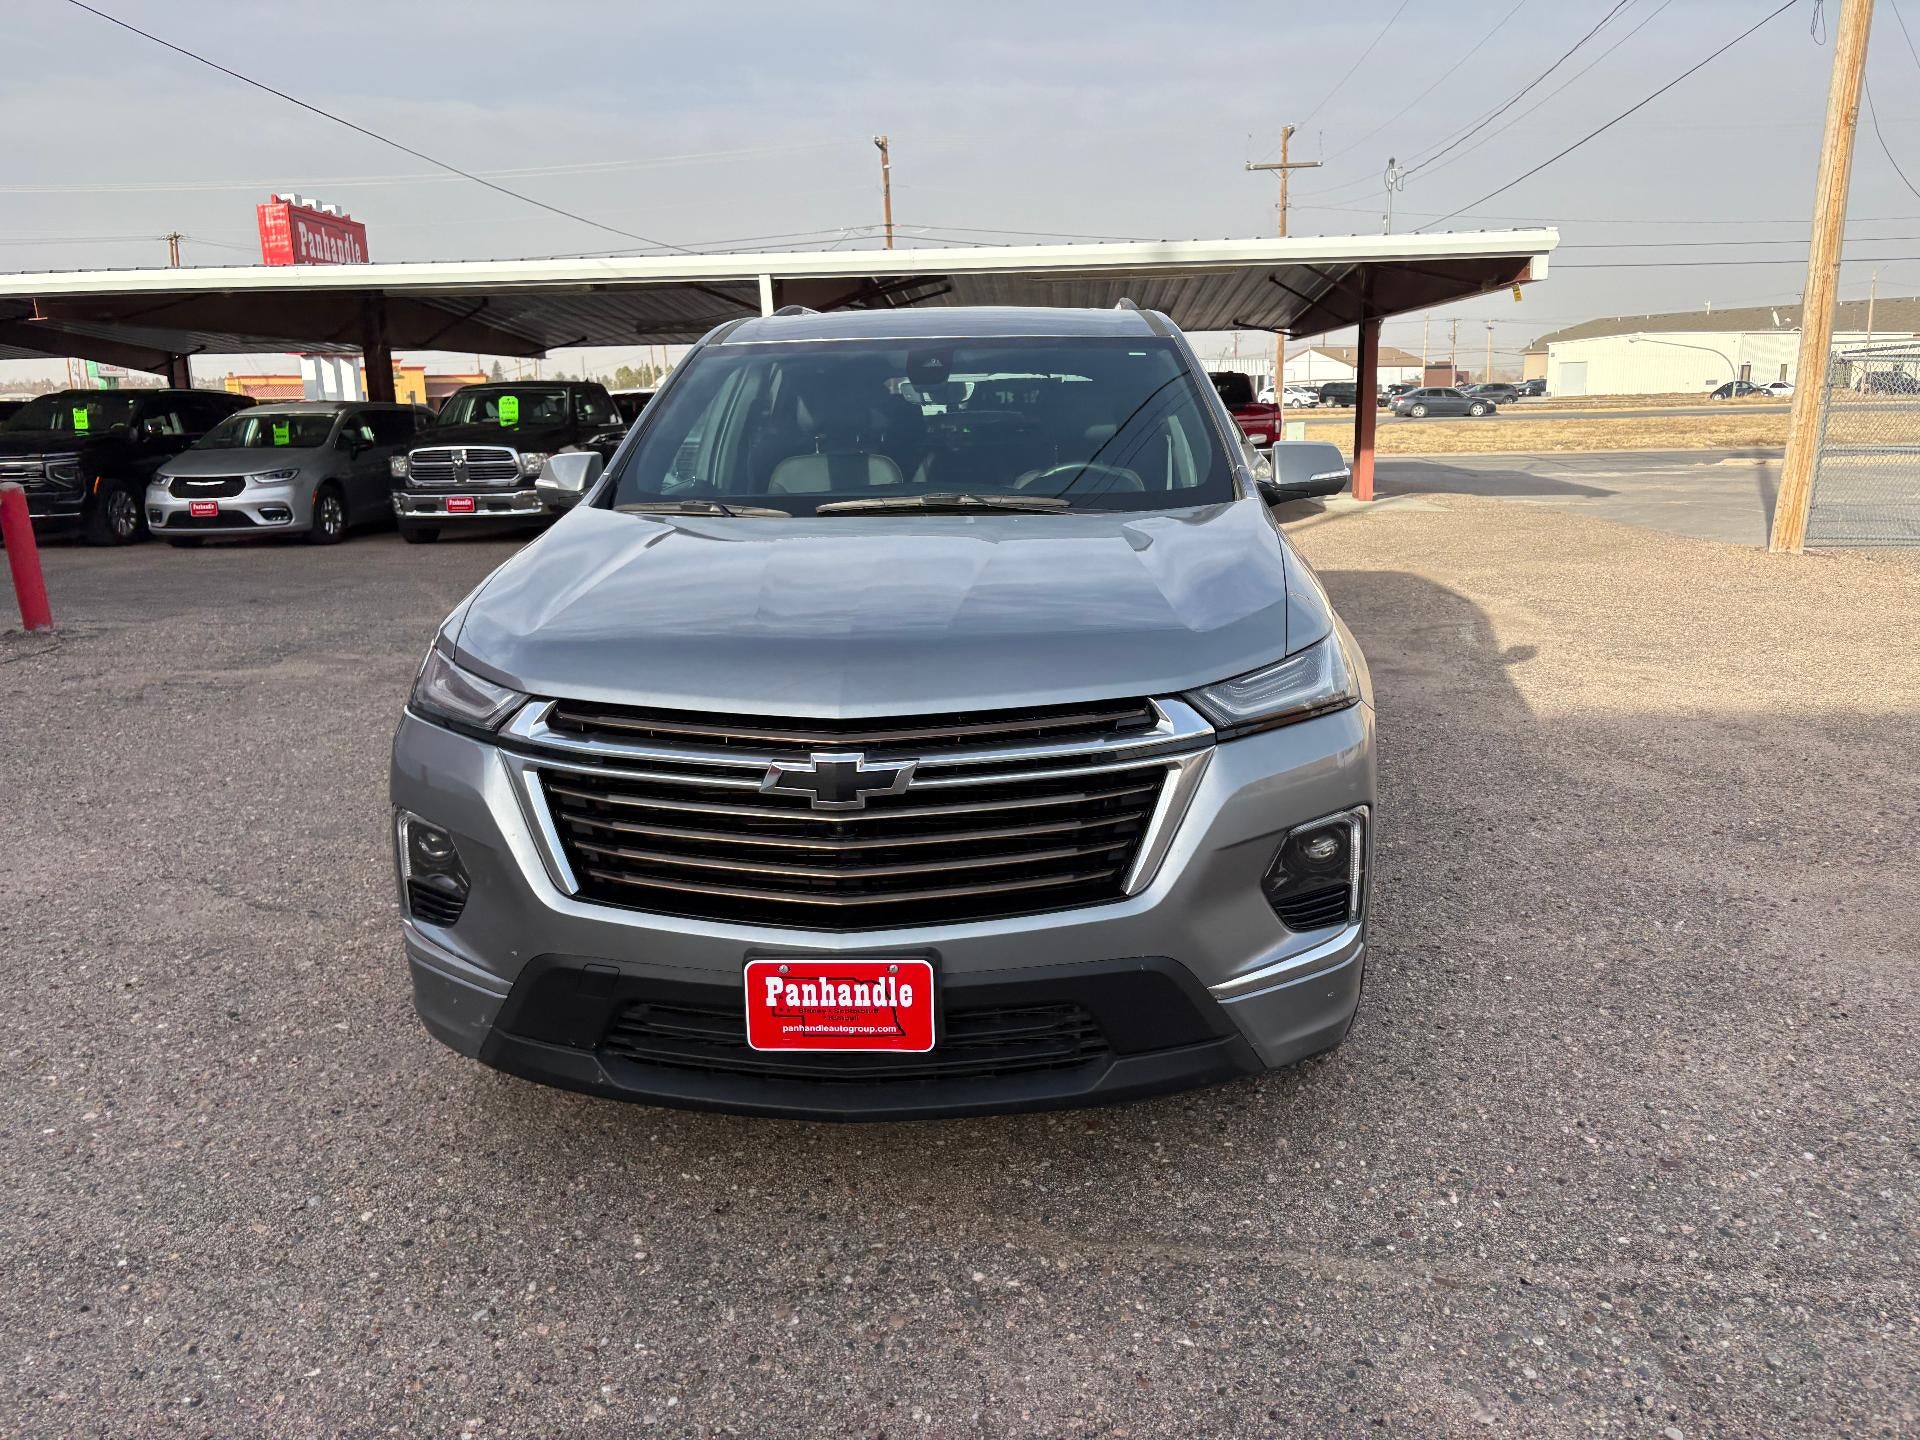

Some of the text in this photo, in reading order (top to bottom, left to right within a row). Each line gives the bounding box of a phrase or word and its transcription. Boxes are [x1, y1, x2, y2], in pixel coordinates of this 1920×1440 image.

[298, 221, 362, 264] Panhandle
[765, 976, 913, 1008] Panhandle
[782, 1024, 897, 1034] panhandleautogroup.com
